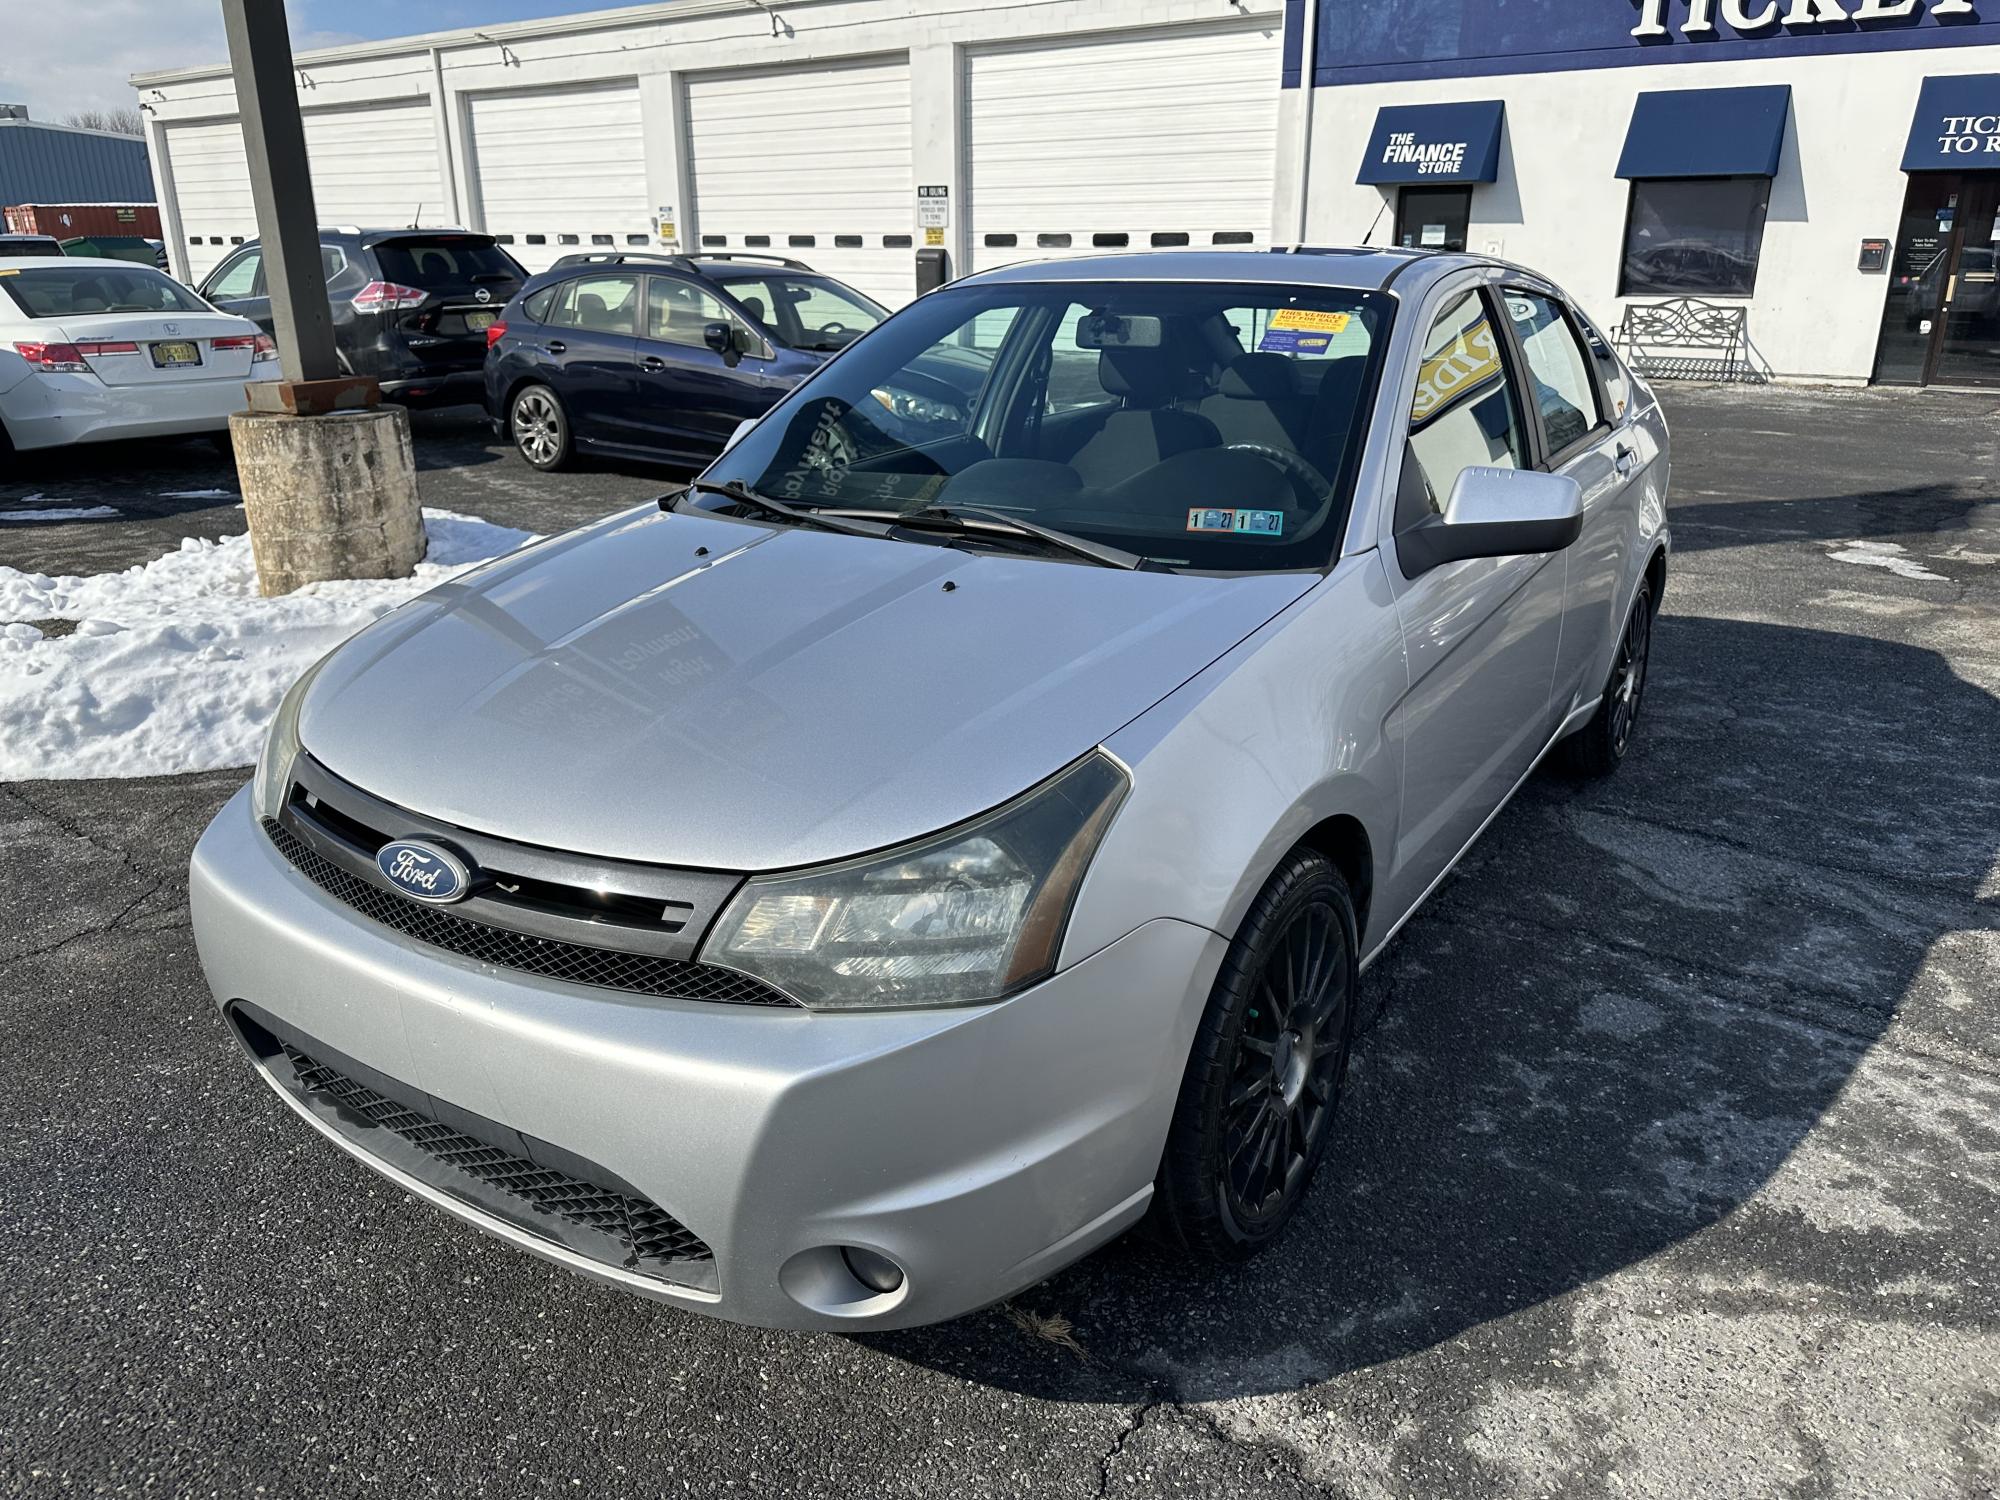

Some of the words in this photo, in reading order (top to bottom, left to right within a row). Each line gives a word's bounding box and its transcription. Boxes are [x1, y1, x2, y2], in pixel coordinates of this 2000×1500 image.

[1630, 0, 1974, 36] TIC
[1943, 116, 2000, 135] TIC
[1390, 133, 1415, 145] THE
[1938, 136, 1978, 153] TO
[1382, 143, 1467, 163] FINANCE
[1418, 161, 1461, 174] STORE
[1304, 312, 1344, 320] VEHICLE
[1192, 514, 1199, 527] 1
[1221, 513, 1232, 528] 27
[1240, 515, 1245, 529] 1
[1268, 515, 1279, 530] 27
[389, 848, 443, 891] Ford
